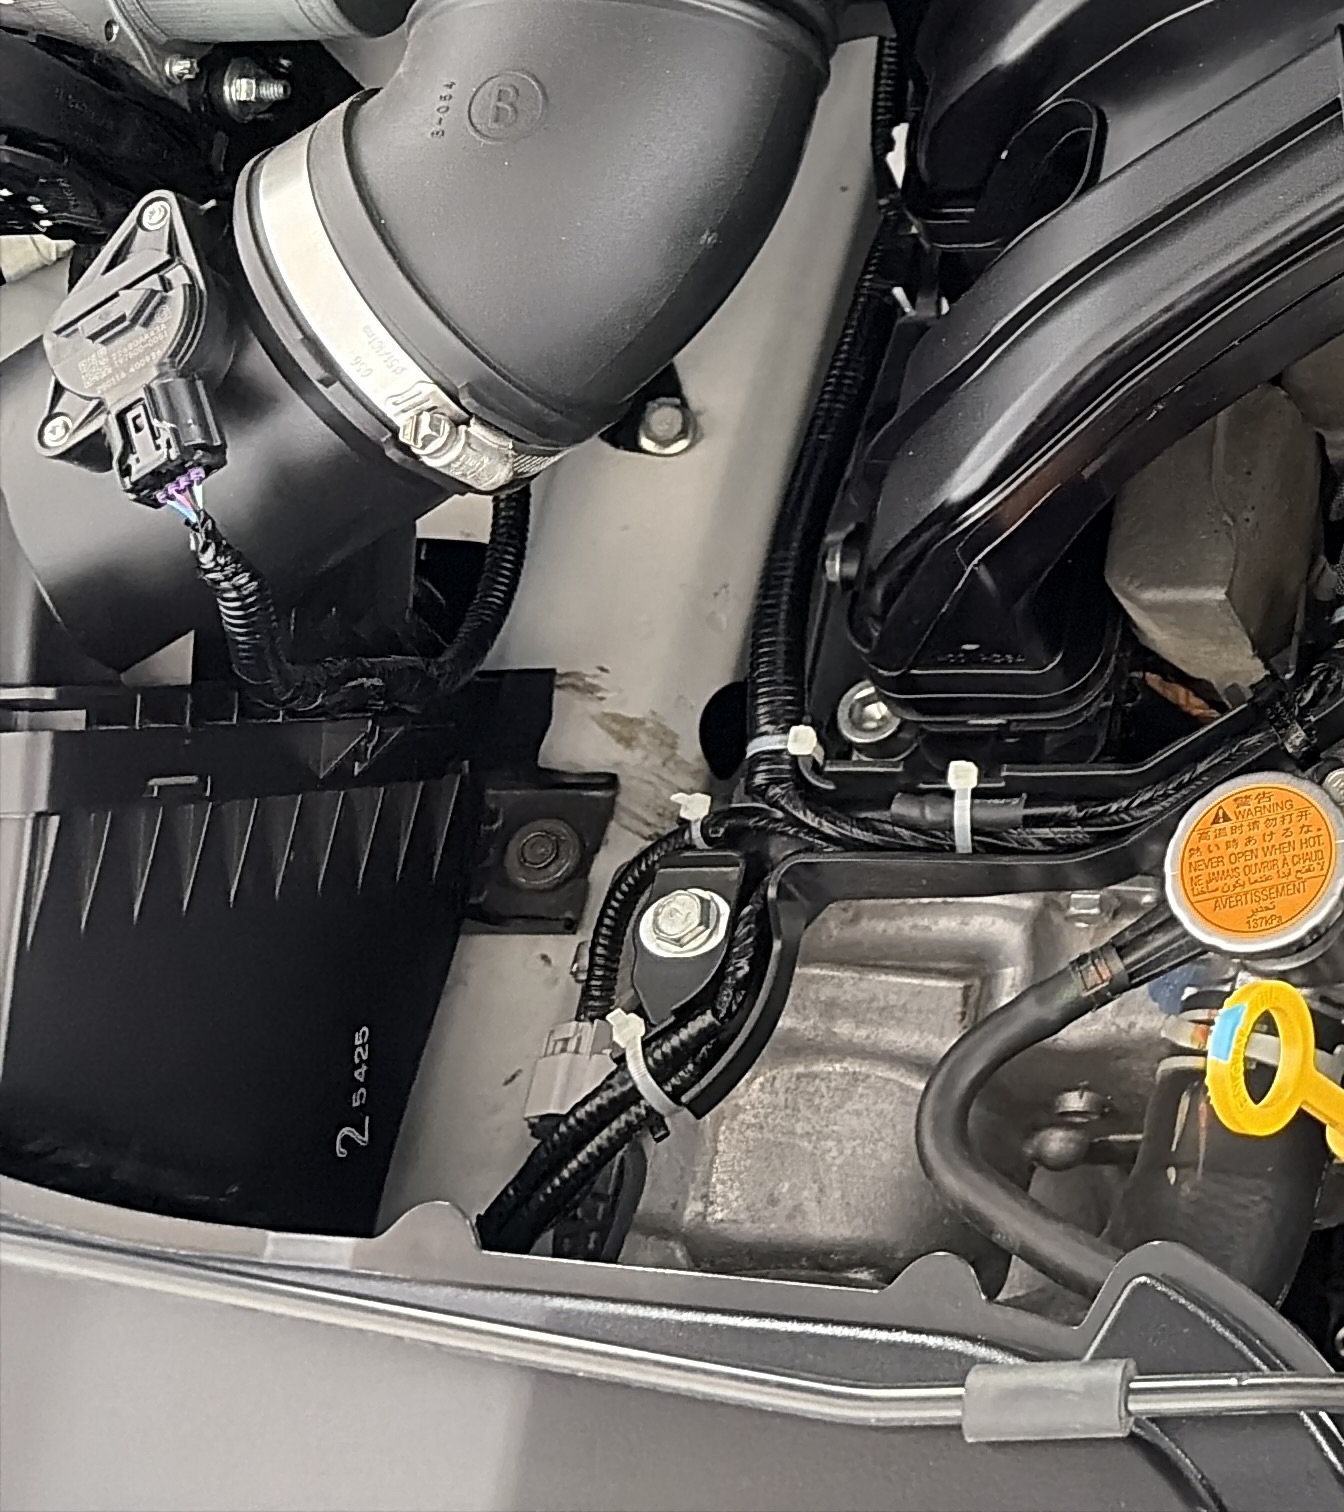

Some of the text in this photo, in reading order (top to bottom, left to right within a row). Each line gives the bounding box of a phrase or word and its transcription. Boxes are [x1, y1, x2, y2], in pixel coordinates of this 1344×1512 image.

[1233, 799, 1294, 820] WARNING
[1188, 834, 1325, 873] NEVER OPEN WHEN HOT.
[1190, 874, 1203, 888] NE
[1205, 867, 1241, 885] JAMAIS
[1243, 858, 1279, 876] OUVRIR
[1213, 880, 1308, 912] AVERTISSEMENT
